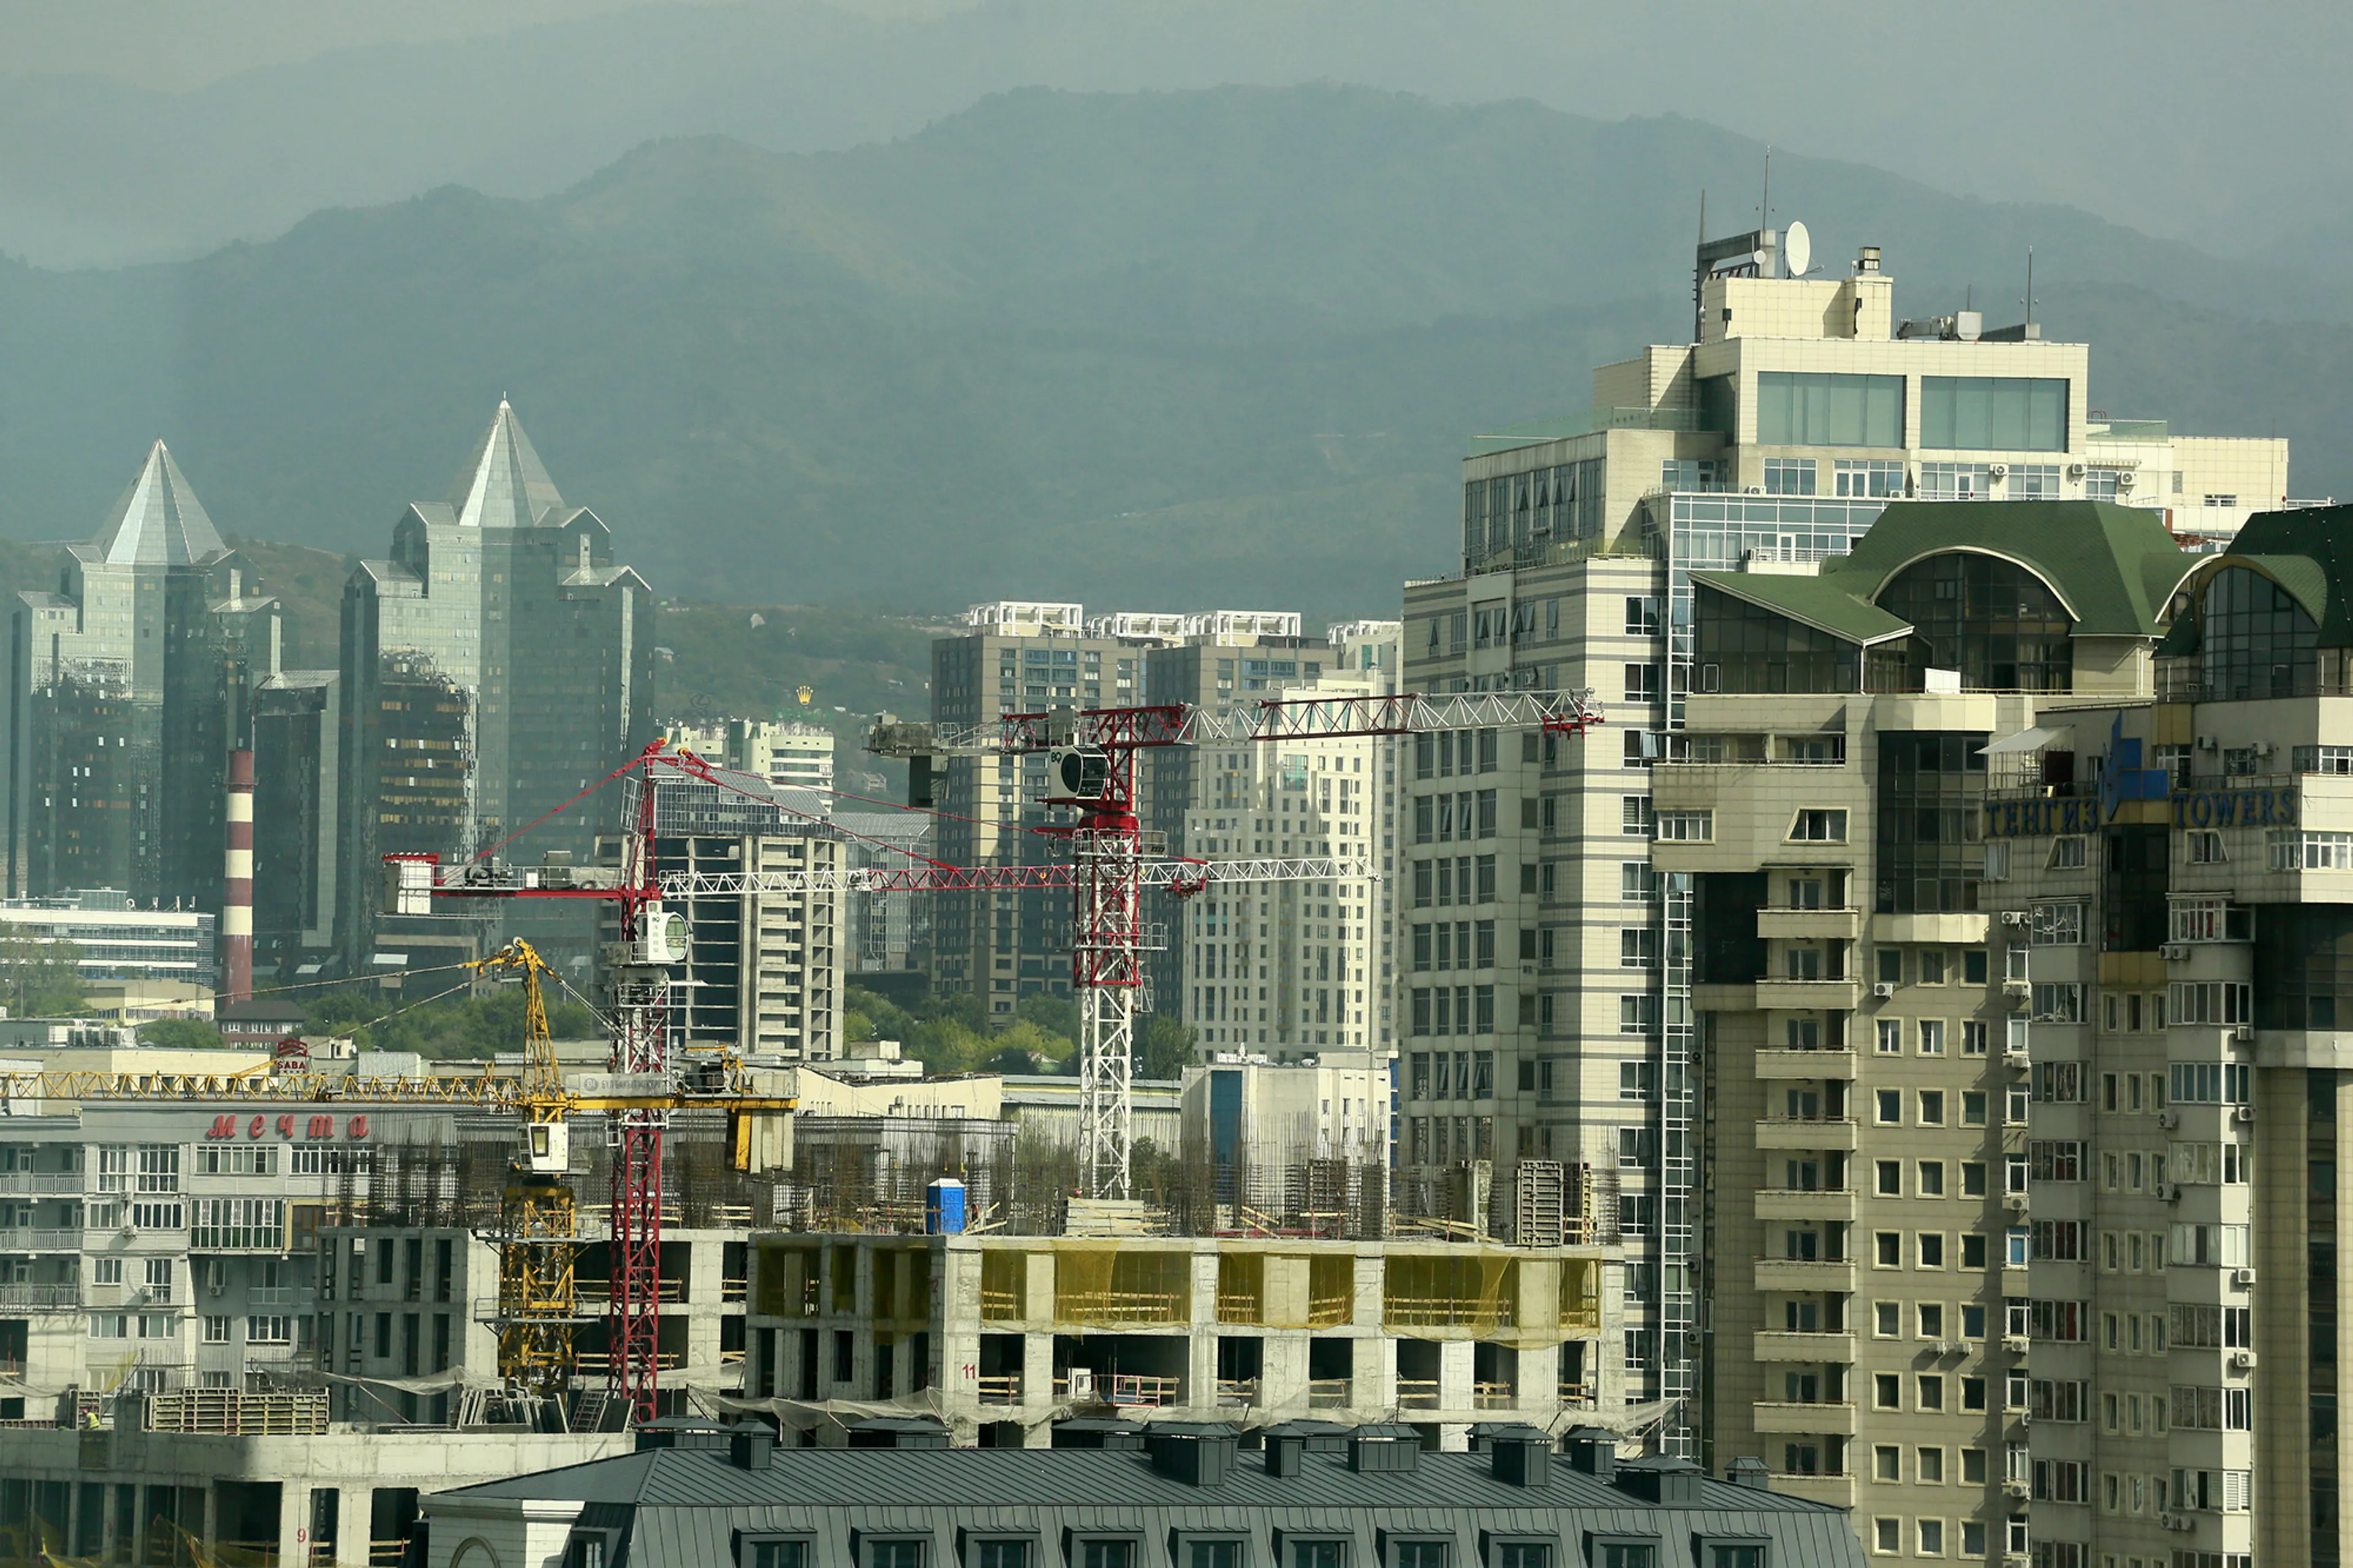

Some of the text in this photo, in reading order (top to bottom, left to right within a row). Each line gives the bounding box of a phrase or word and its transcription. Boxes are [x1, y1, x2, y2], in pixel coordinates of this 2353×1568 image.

[1985, 798, 2098, 837] ТЕНГИЗ
[2172, 789, 2297, 828] TOWERS
[962, 1364, 976, 1380] 11
[297, 1528, 306, 1543] 9
